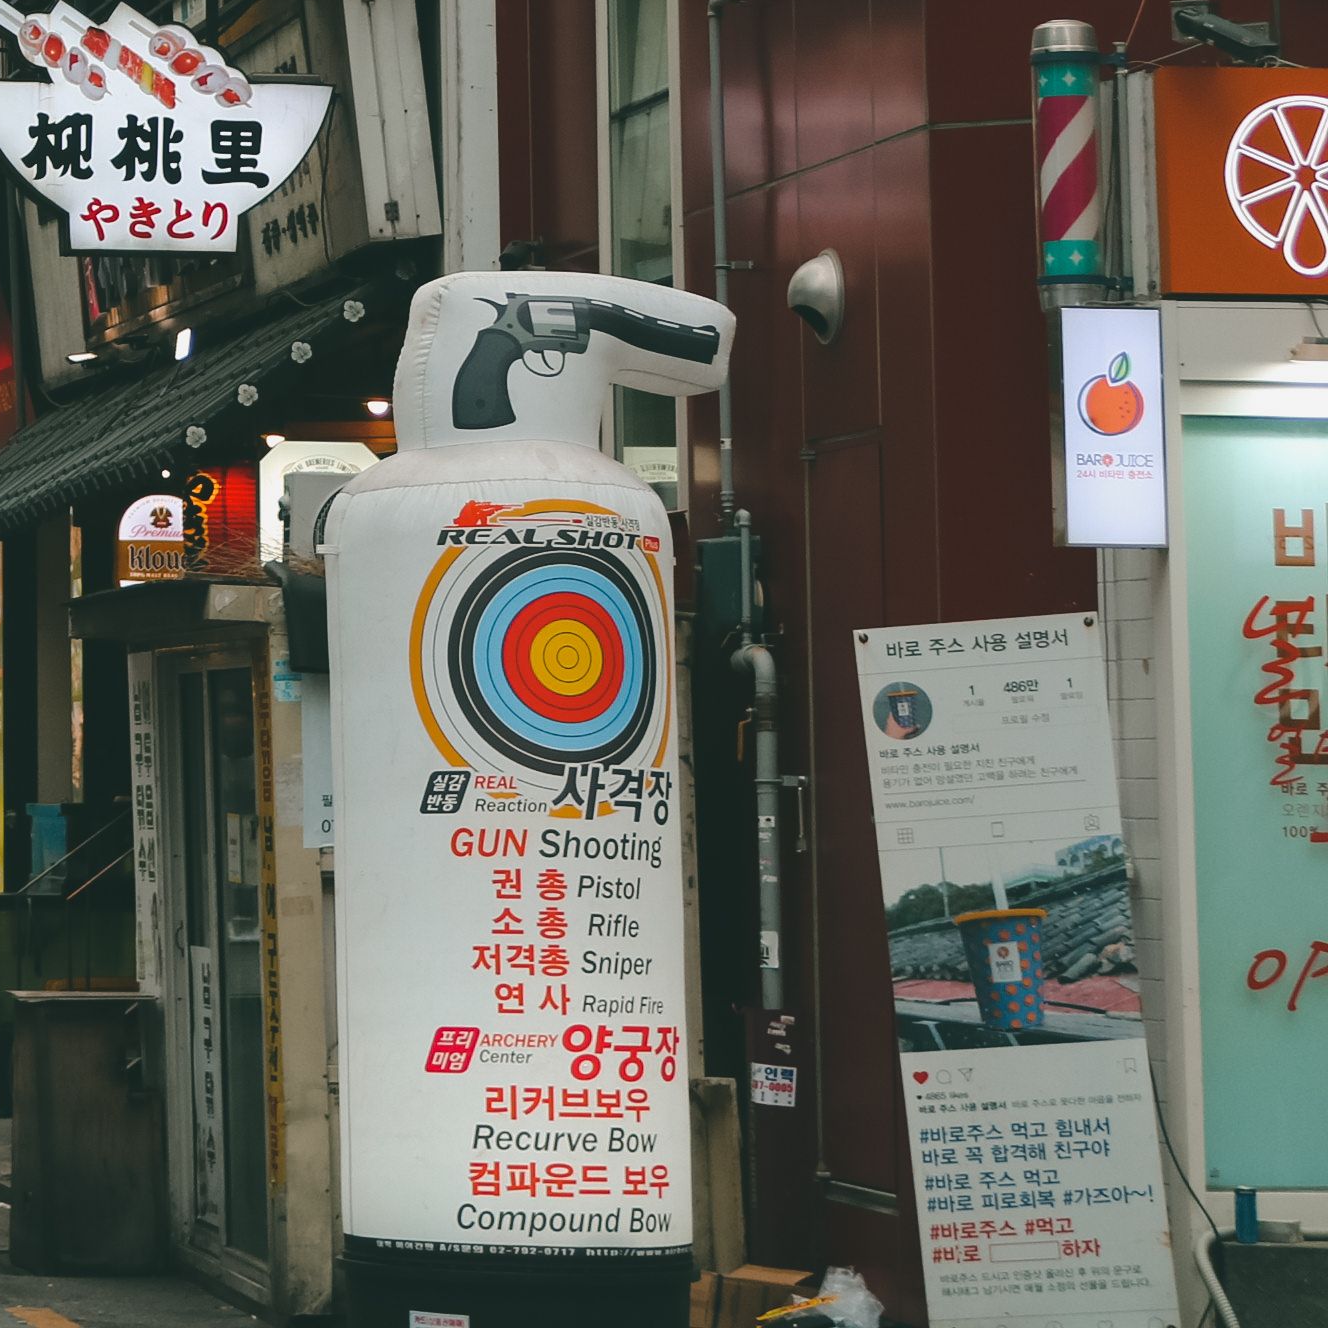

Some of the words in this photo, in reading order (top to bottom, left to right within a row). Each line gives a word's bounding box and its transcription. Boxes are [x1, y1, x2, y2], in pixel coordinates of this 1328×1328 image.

[80, 197, 231, 243] やきとり
[1116, 454, 1153, 467] JUICE
[129, 524, 184, 539] Premiu
[436, 529, 545, 548] REAL
[545, 531, 643, 551] SHOT
[128, 544, 186, 571] Klou
[886, 640, 922, 659] 바로
[929, 637, 964, 656] 주스
[972, 633, 1007, 653] 사용
[1015, 628, 1069, 650] 설명서
[1004, 679, 1039, 694] 486만
[879, 748, 899, 759] 바로
[903, 747, 923, 758] 주스
[927, 745, 946, 757] 사용
[950, 743, 980, 755] 설명서
[433, 774, 466, 791] 실감
[474, 775, 518, 789] REAL
[426, 793, 460, 811] 반동
[474, 797, 548, 814] Reaction
[552, 764, 673, 825] 사격장
[451, 827, 528, 859] GUN
[539, 828, 663, 869] Shooting
[578, 875, 642, 901] Pistol
[587, 913, 640, 938] Rifle
[471, 944, 571, 978] 저격총
[581, 951, 652, 980] Sniper
[582, 994, 635, 1018] Rapid
[640, 995, 664, 1015] Fire
[435, 1029, 475, 1050] 프리
[479, 1033, 558, 1049] ARCHERY
[431, 1051, 467, 1071] 미엄
[479, 1050, 532, 1065] Center
[562, 1024, 679, 1082] 양궁장
[485, 1085, 650, 1121] 리커브보우
[473, 1124, 598, 1152] Recurve
[608, 1127, 657, 1153] Bow
[920, 1123, 1004, 1144] #바로주스
[1011, 1121, 1048, 1139] 먹고
[1055, 1117, 1111, 1138] 힘내서
[922, 1147, 959, 1167] 바로
[965, 1146, 984, 1164] 꼭
[991, 1142, 1046, 1162] 합격해
[1054, 1139, 1110, 1160] 친구야
[469, 1161, 611, 1198] 컴파운드
[624, 1164, 670, 1198] 보우
[924, 1172, 972, 1191] #바로
[979, 1171, 1015, 1189] 주스
[1024, 1169, 1061, 1187] 먹고
[927, 1194, 974, 1213] #바로
[981, 1190, 1056, 1210] 피로회복
[457, 1203, 620, 1238] Compound
[629, 1207, 672, 1233] Bow
[929, 1219, 1018, 1241] #바로주스
[1025, 1217, 1074, 1236] #먹고
[1061, 1238, 1101, 1260] 하자
